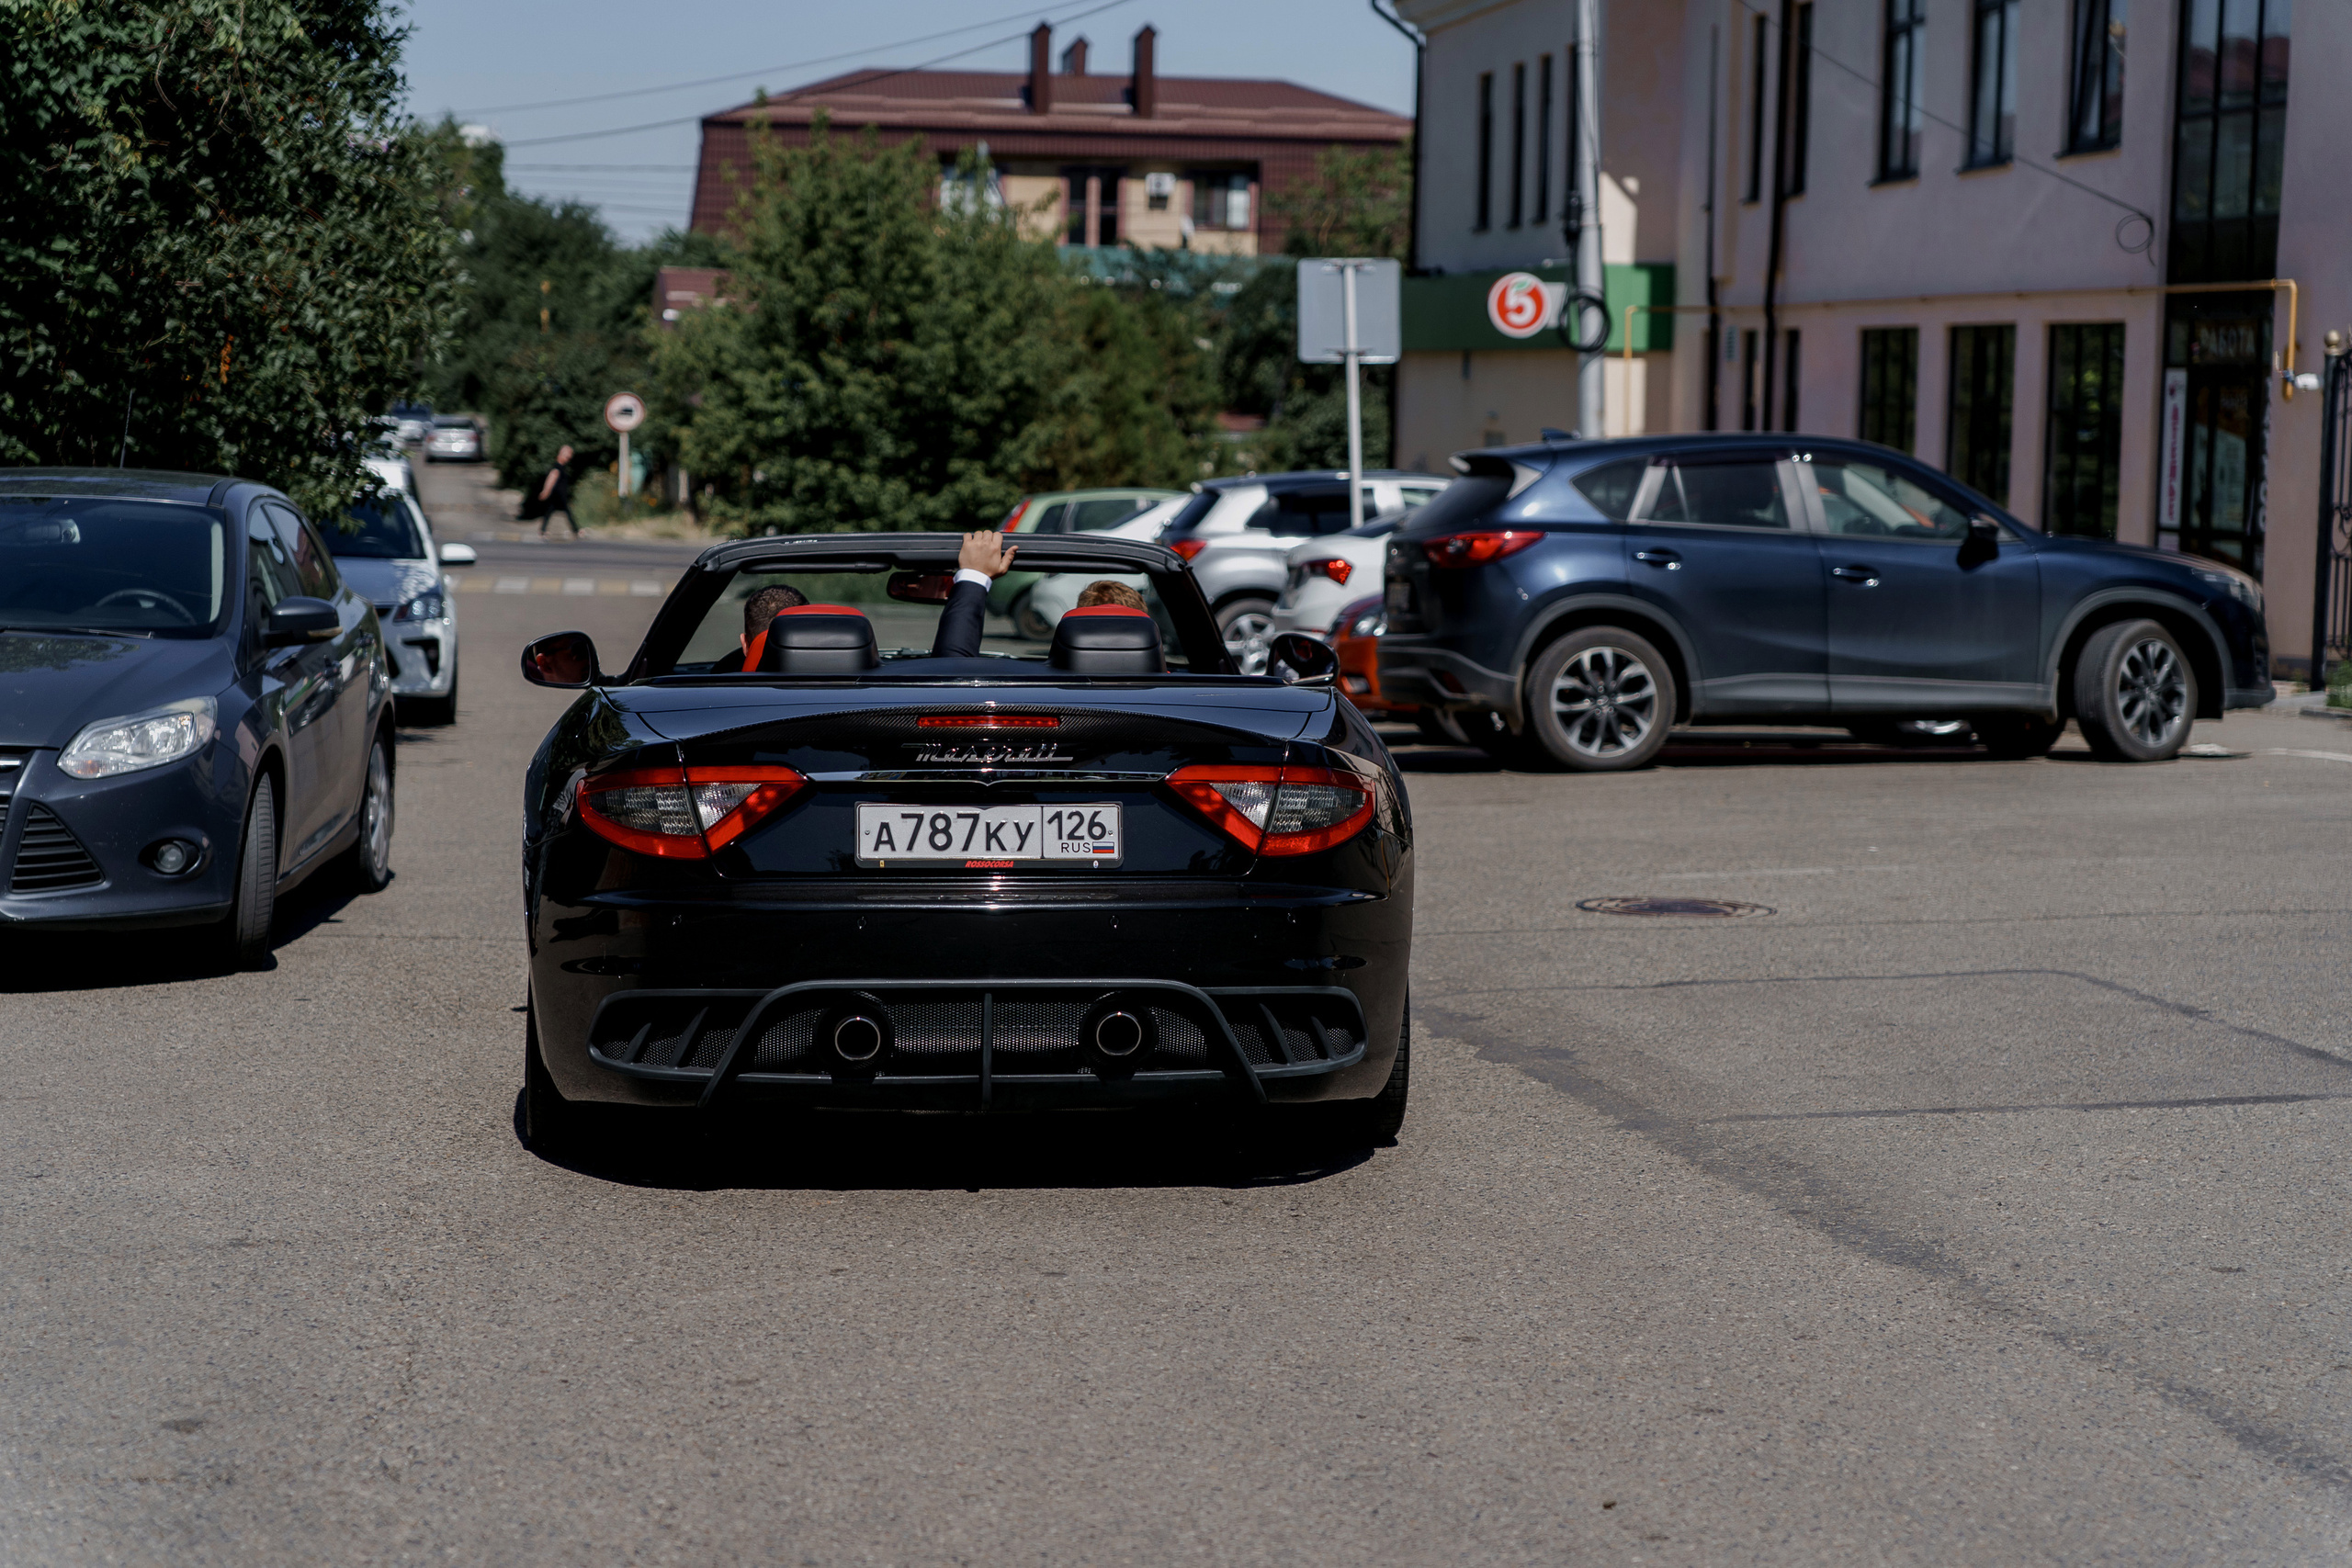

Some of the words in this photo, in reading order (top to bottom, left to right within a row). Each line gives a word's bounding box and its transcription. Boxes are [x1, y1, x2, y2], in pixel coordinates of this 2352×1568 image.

[1504, 279, 1537, 326] 5
[901, 743, 1073, 762] Maserati
[874, 812, 1035, 852] А787КУ
[1047, 810, 1107, 840] 126
[1061, 842, 1091, 853] RUS
